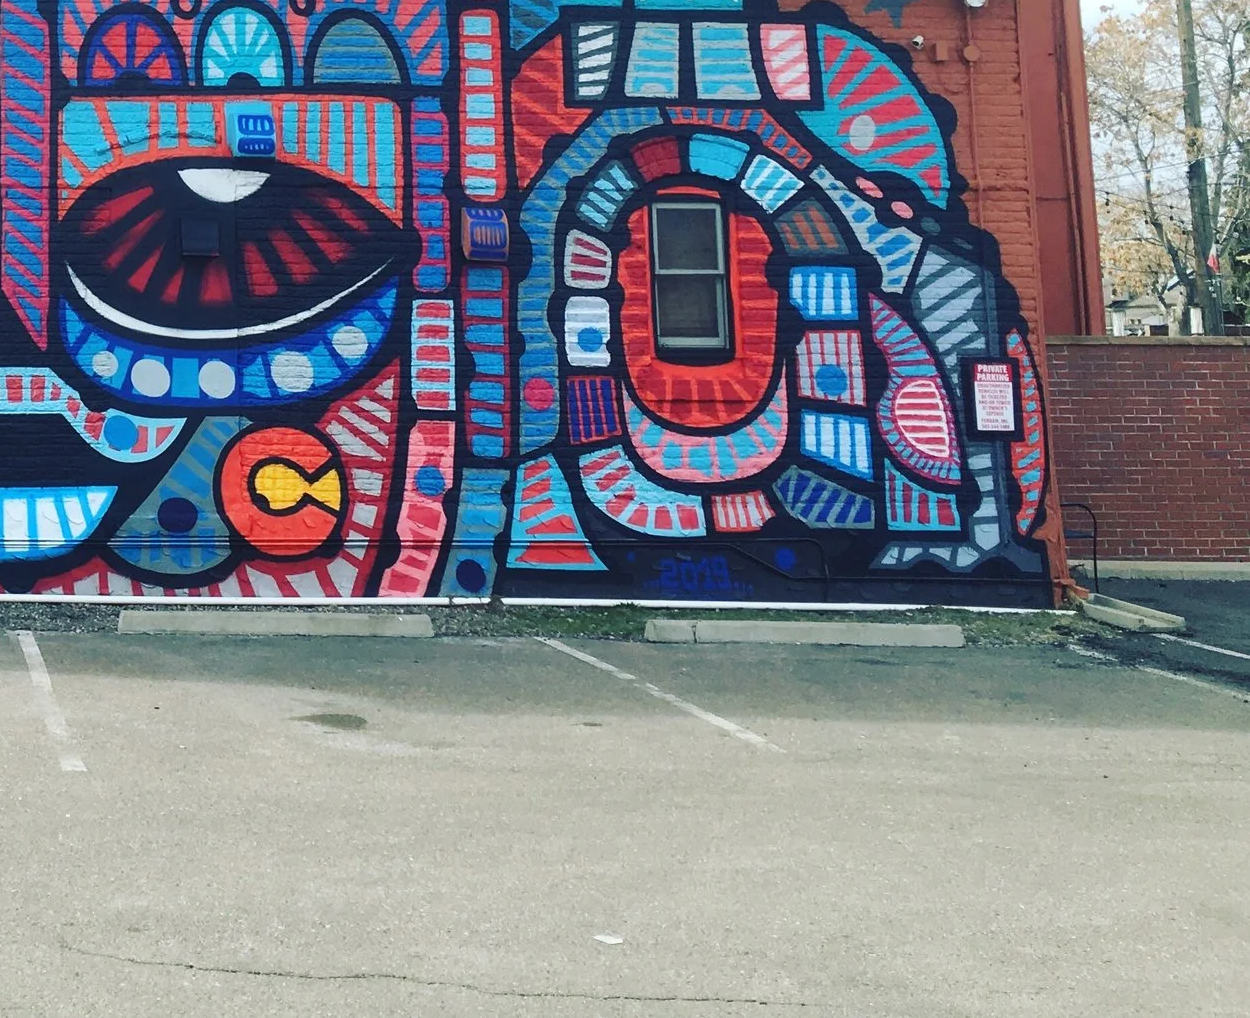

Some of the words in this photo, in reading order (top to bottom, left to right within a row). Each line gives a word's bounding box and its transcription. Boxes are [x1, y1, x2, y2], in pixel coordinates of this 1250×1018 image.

[977, 364, 1008, 373] PRIVATE
[976, 373, 1009, 382] PARKING
[660, 555, 730, 591] 2019
